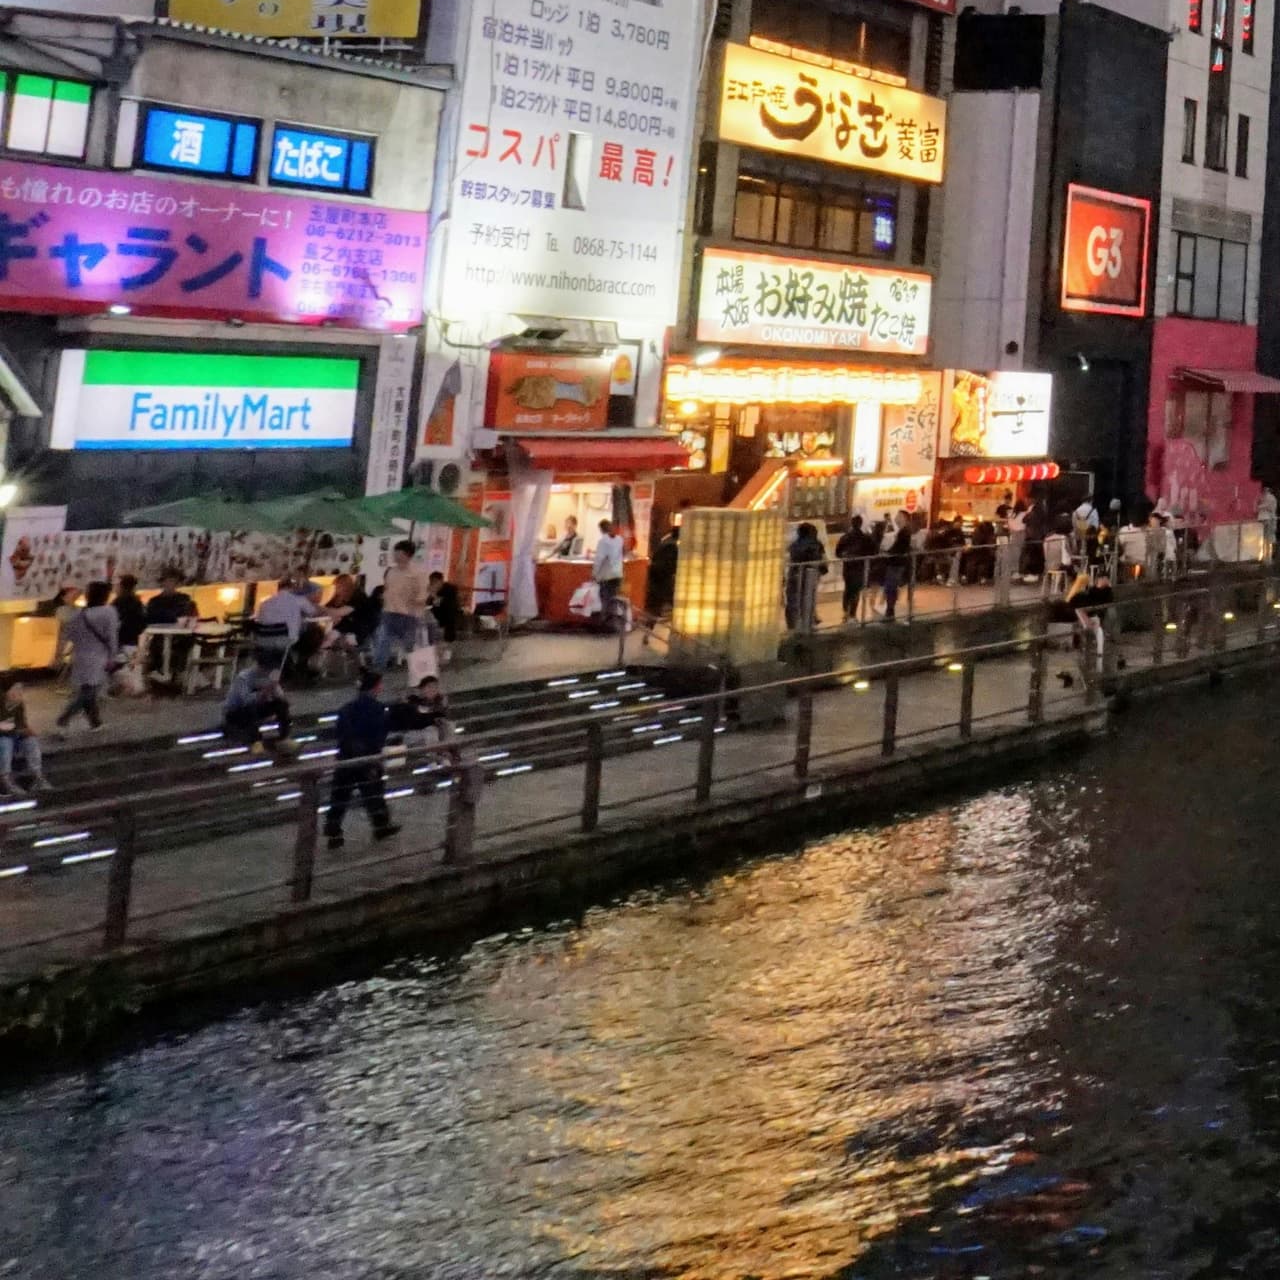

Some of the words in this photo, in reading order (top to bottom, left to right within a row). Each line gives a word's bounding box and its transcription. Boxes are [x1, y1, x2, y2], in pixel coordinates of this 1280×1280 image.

[759, 72, 895, 159] うなぎ
[170, 122, 205, 165] 酒
[274, 134, 346, 182] たばこ
[465, 123, 561, 171] コスパ
[459, 179, 556, 211] 幹部スタッフ募集
[468, 223, 531, 253] 予約受付
[573, 236, 658, 262] 0868-75-1144
[1086, 225, 1123, 278] G3
[715, 264, 745, 297] 本場
[753, 267, 871, 328] お好み焼
[869, 303, 917, 347] たこ焼
[129, 392, 313, 437] FamilyMart
